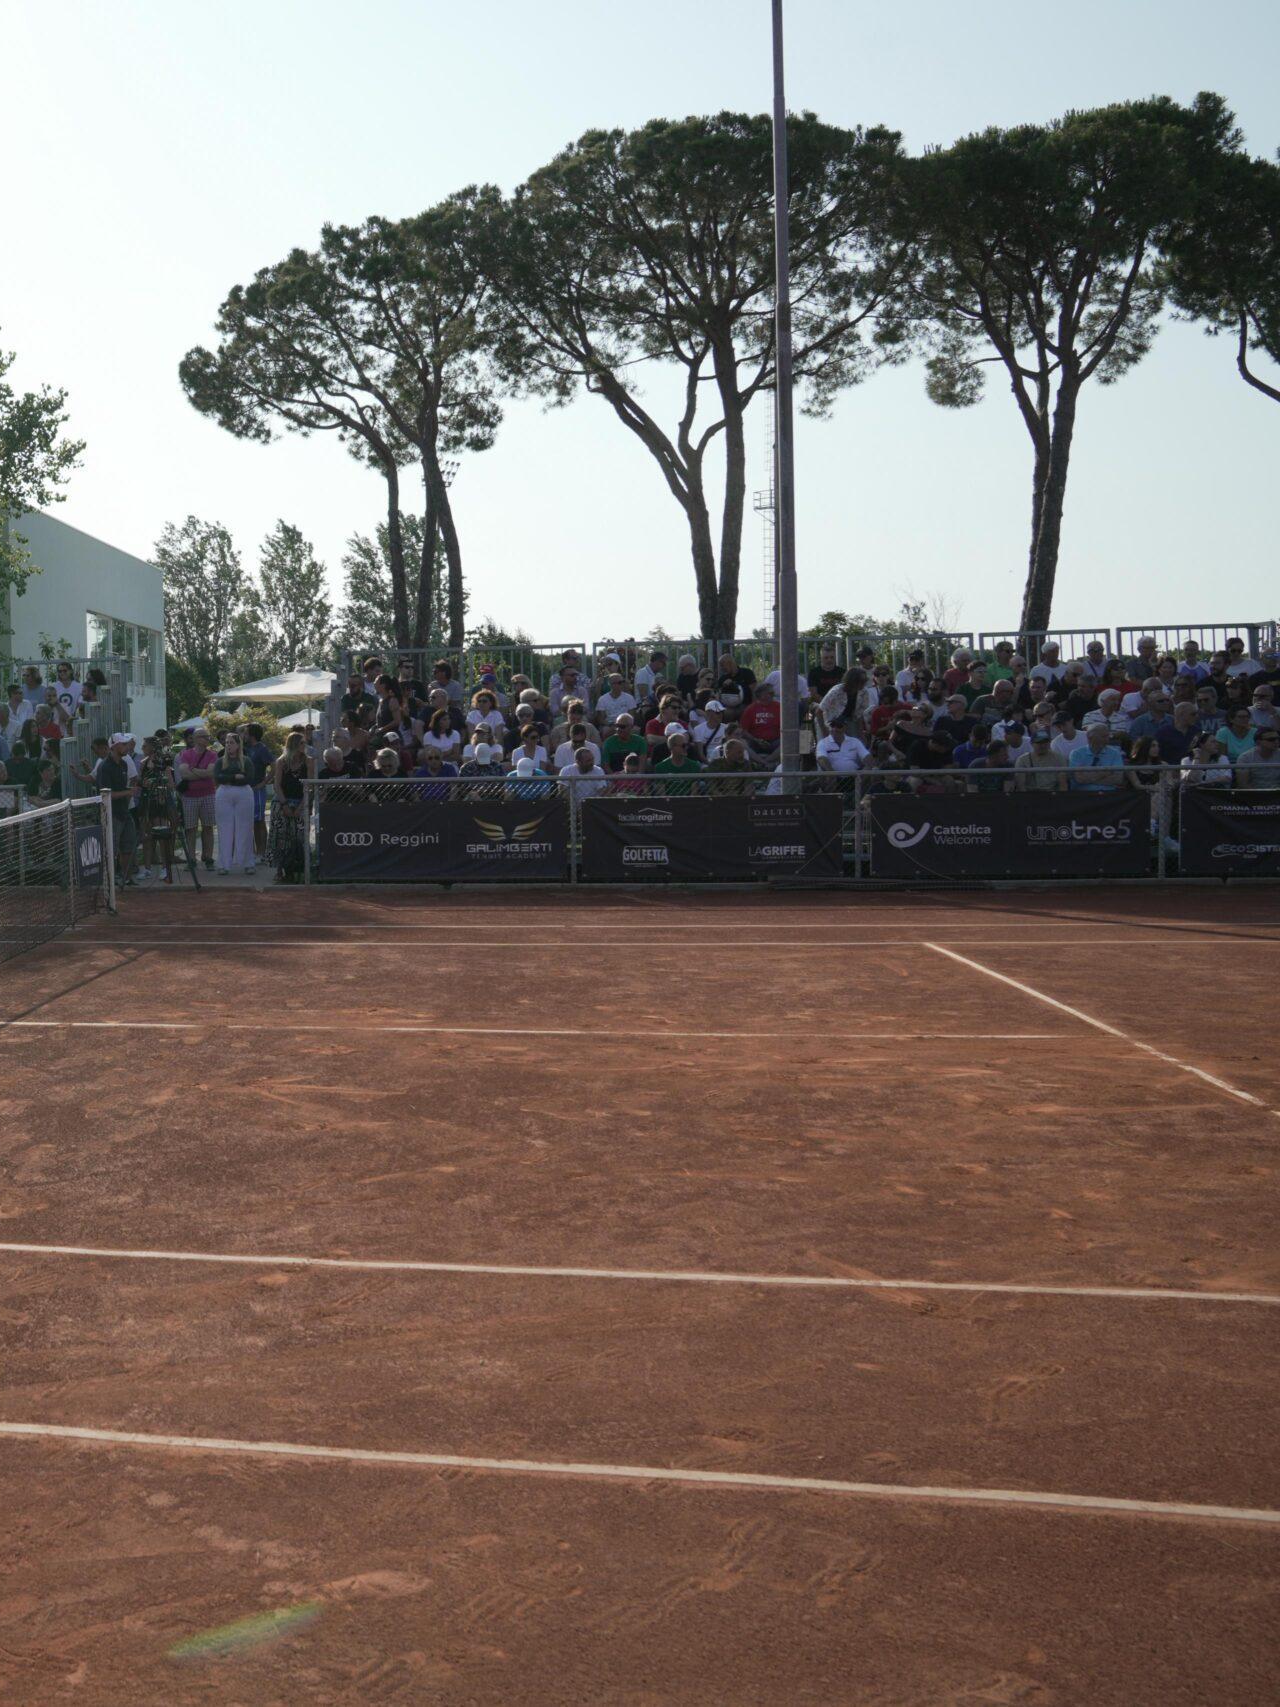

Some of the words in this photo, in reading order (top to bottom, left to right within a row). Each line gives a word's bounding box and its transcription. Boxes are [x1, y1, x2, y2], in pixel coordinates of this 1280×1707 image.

[933, 823, 991, 835] Cattolica
[380, 833, 440, 847] Reggini
[933, 834, 992, 845] Welcome
[465, 842, 552, 853] GALIMBERTI
[622, 848, 668, 861] GOLFETTA
